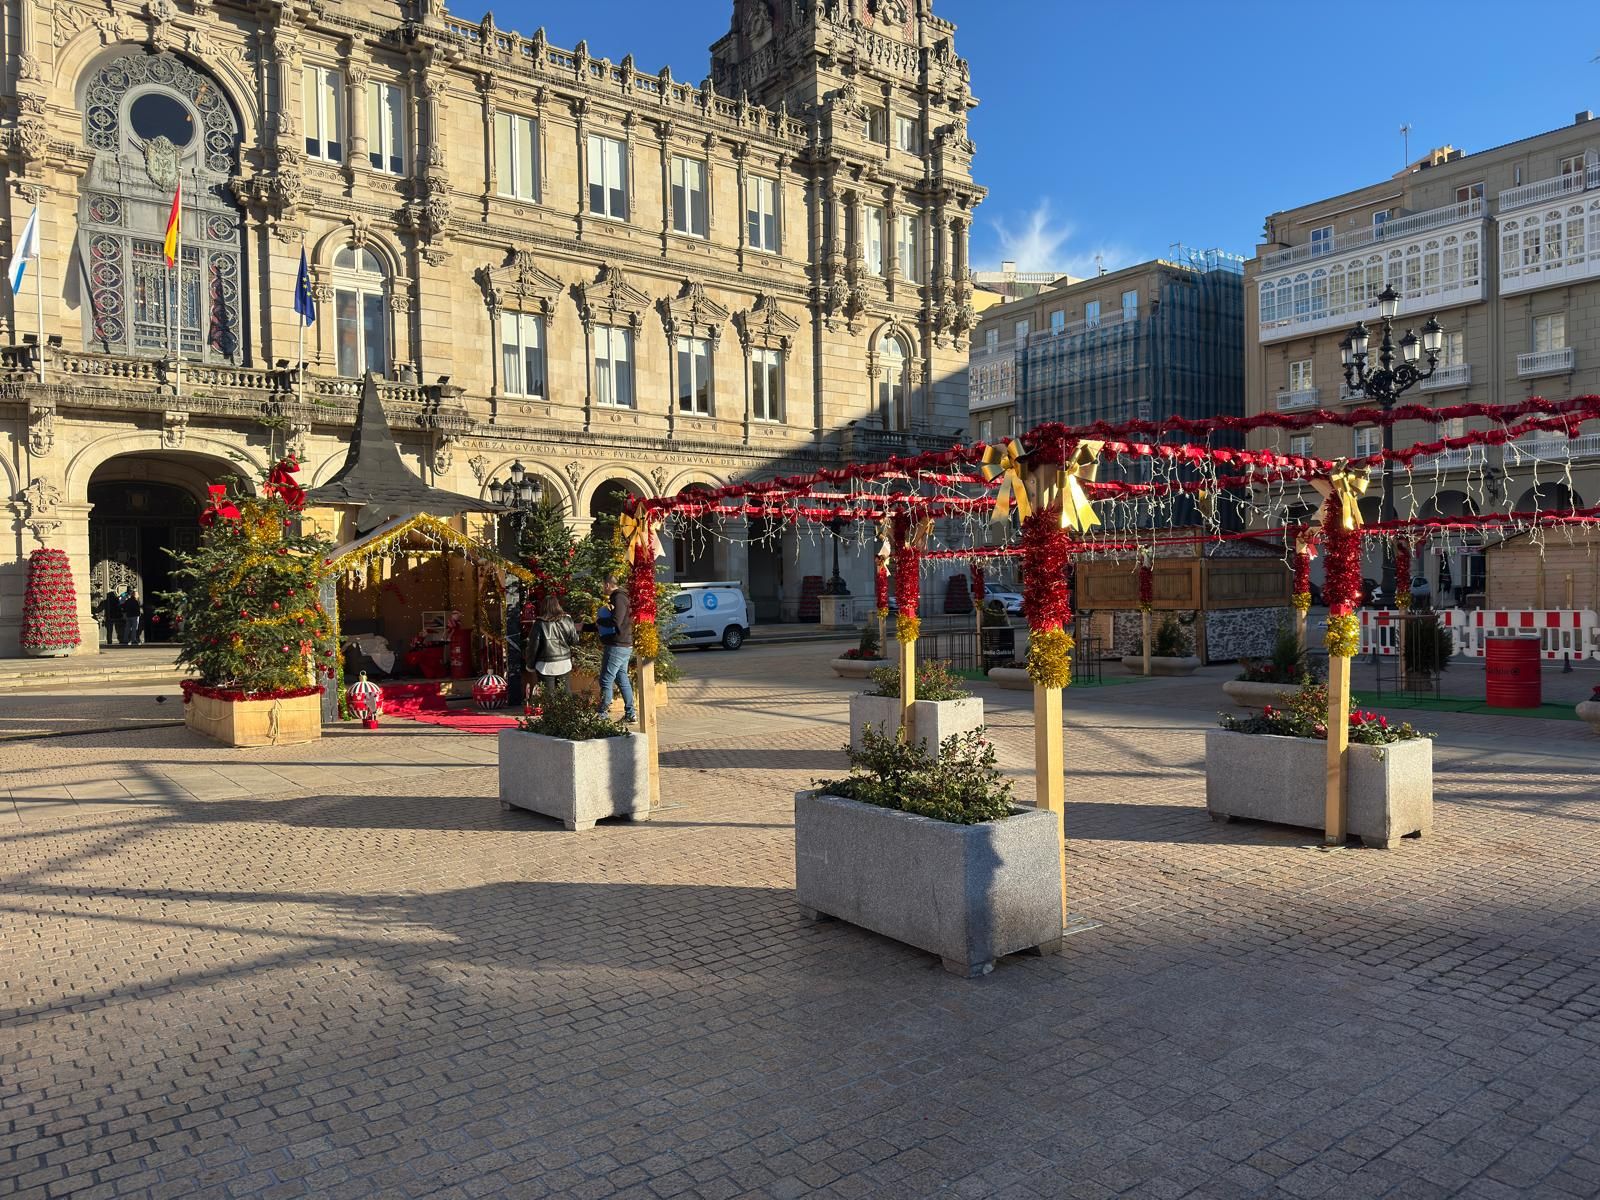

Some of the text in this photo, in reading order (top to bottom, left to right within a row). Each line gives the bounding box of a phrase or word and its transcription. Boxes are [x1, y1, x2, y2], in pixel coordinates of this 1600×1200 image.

[462, 440, 506, 450] CABEZA
[514, 444, 557, 454] GVARDA
[575, 448, 605, 457] LLAVE
[613, 450, 648, 460] FVERZA
[653, 453, 659, 461] Y
[664, 454, 716, 465] ANTEMVRAL
[720, 458, 736, 466] DEL
[741, 459, 767, 468] REINO
